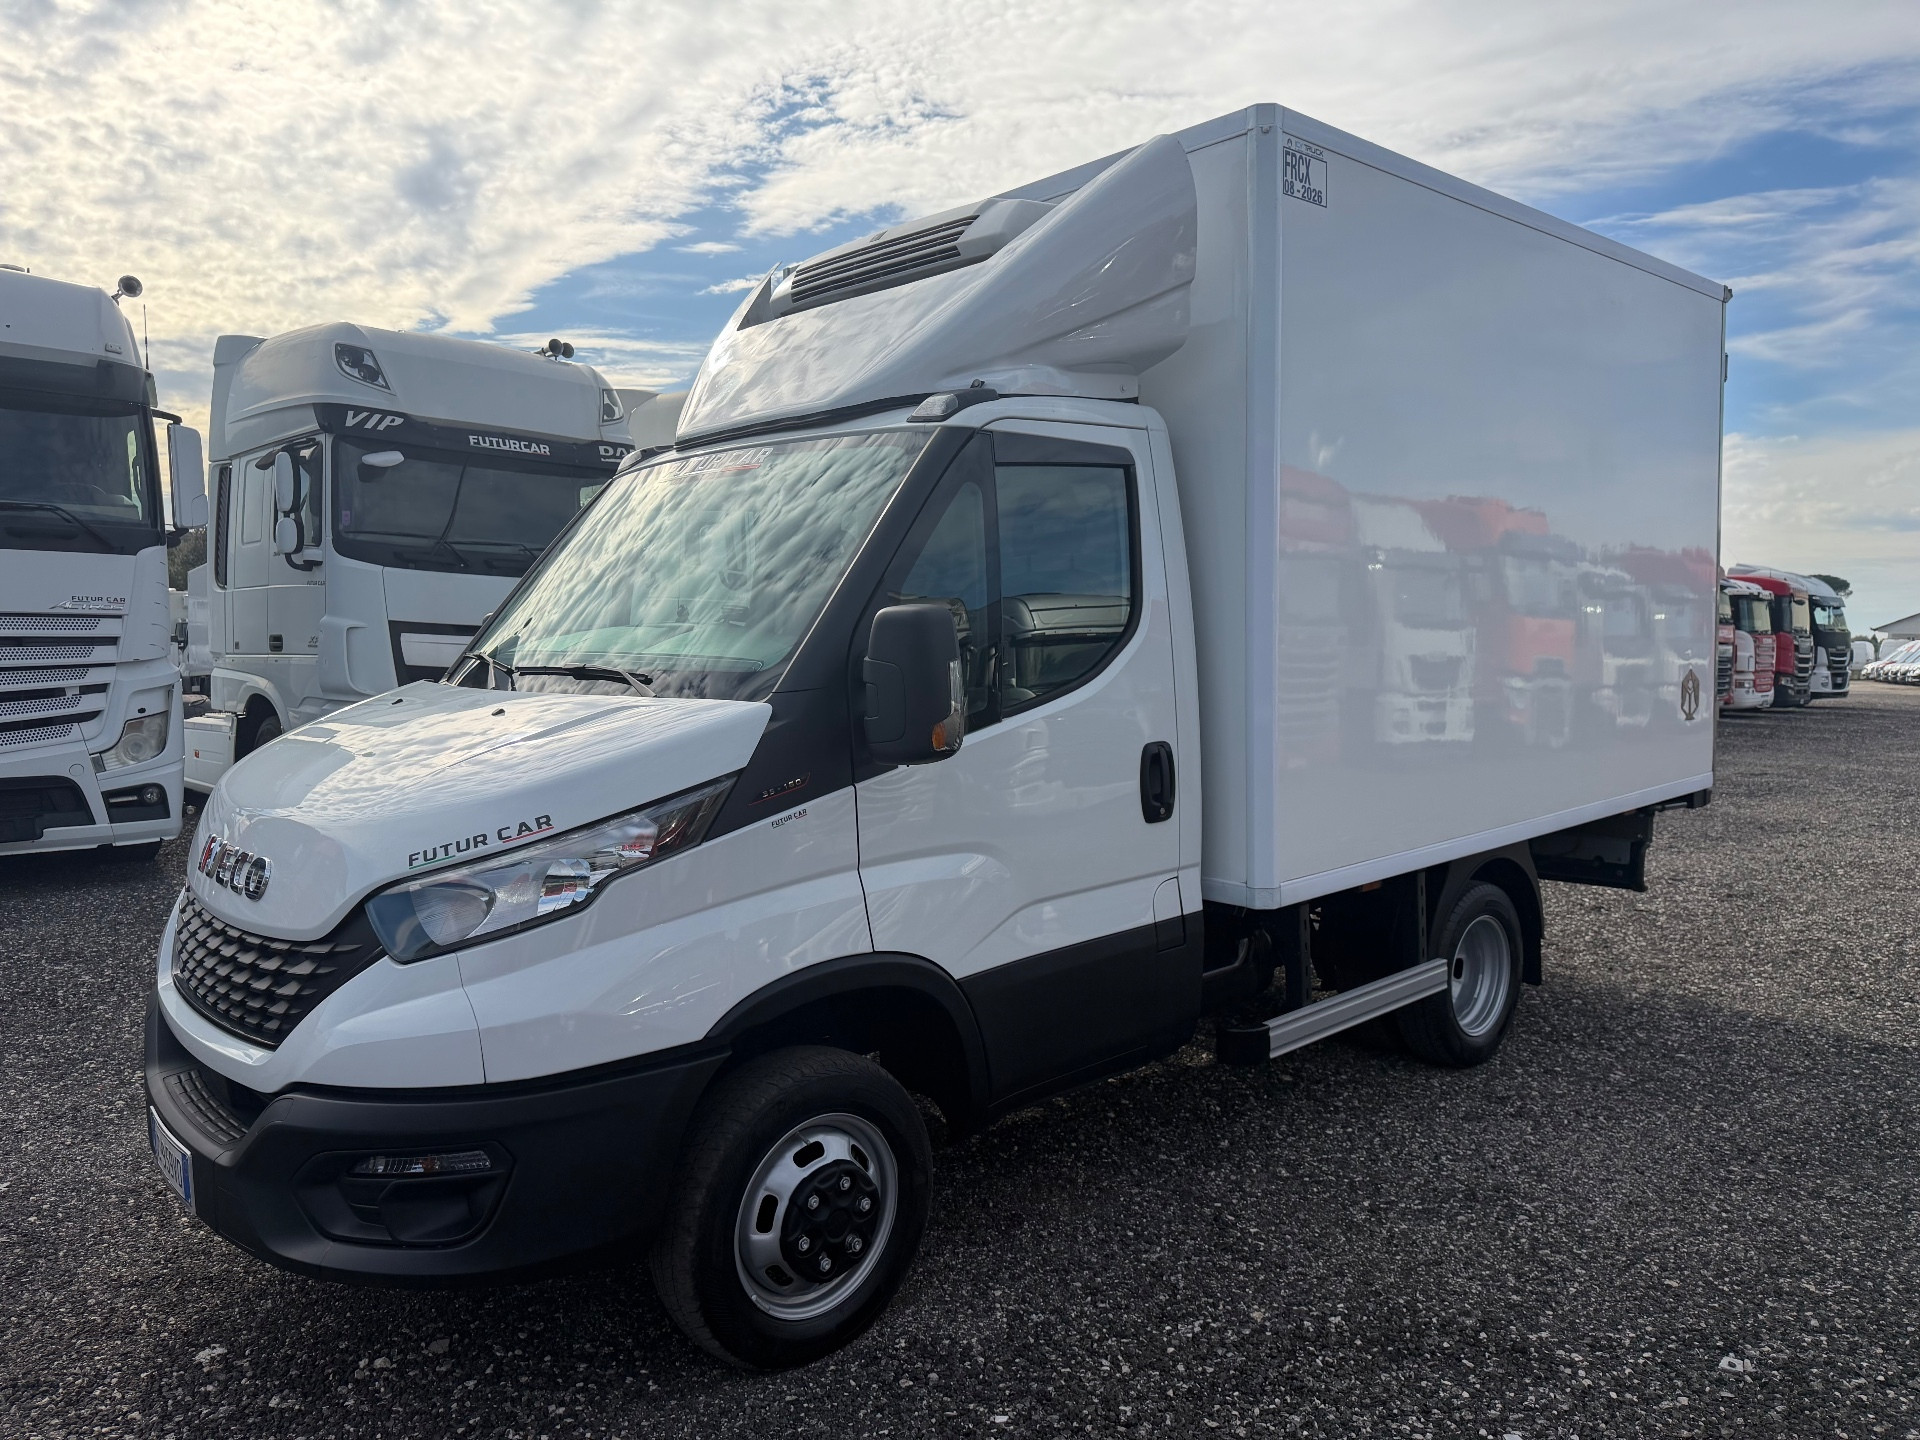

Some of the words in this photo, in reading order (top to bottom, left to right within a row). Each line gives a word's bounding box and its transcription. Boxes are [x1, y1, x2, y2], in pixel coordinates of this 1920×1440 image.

[1303, 144, 1324, 157] TRUCK
[1284, 149, 1312, 186] FRCX
[1284, 178, 1295, 195] 08
[1301, 185, 1323, 204] 2026
[345, 410, 405, 431] VIP
[468, 435, 551, 456] FUTURCAR
[771, 814, 793, 828] FUTUR
[793, 808, 807, 819] CAR
[408, 833, 488, 867] FUTUR
[496, 814, 554, 841] CAR
[197, 833, 272, 902] IVECO
